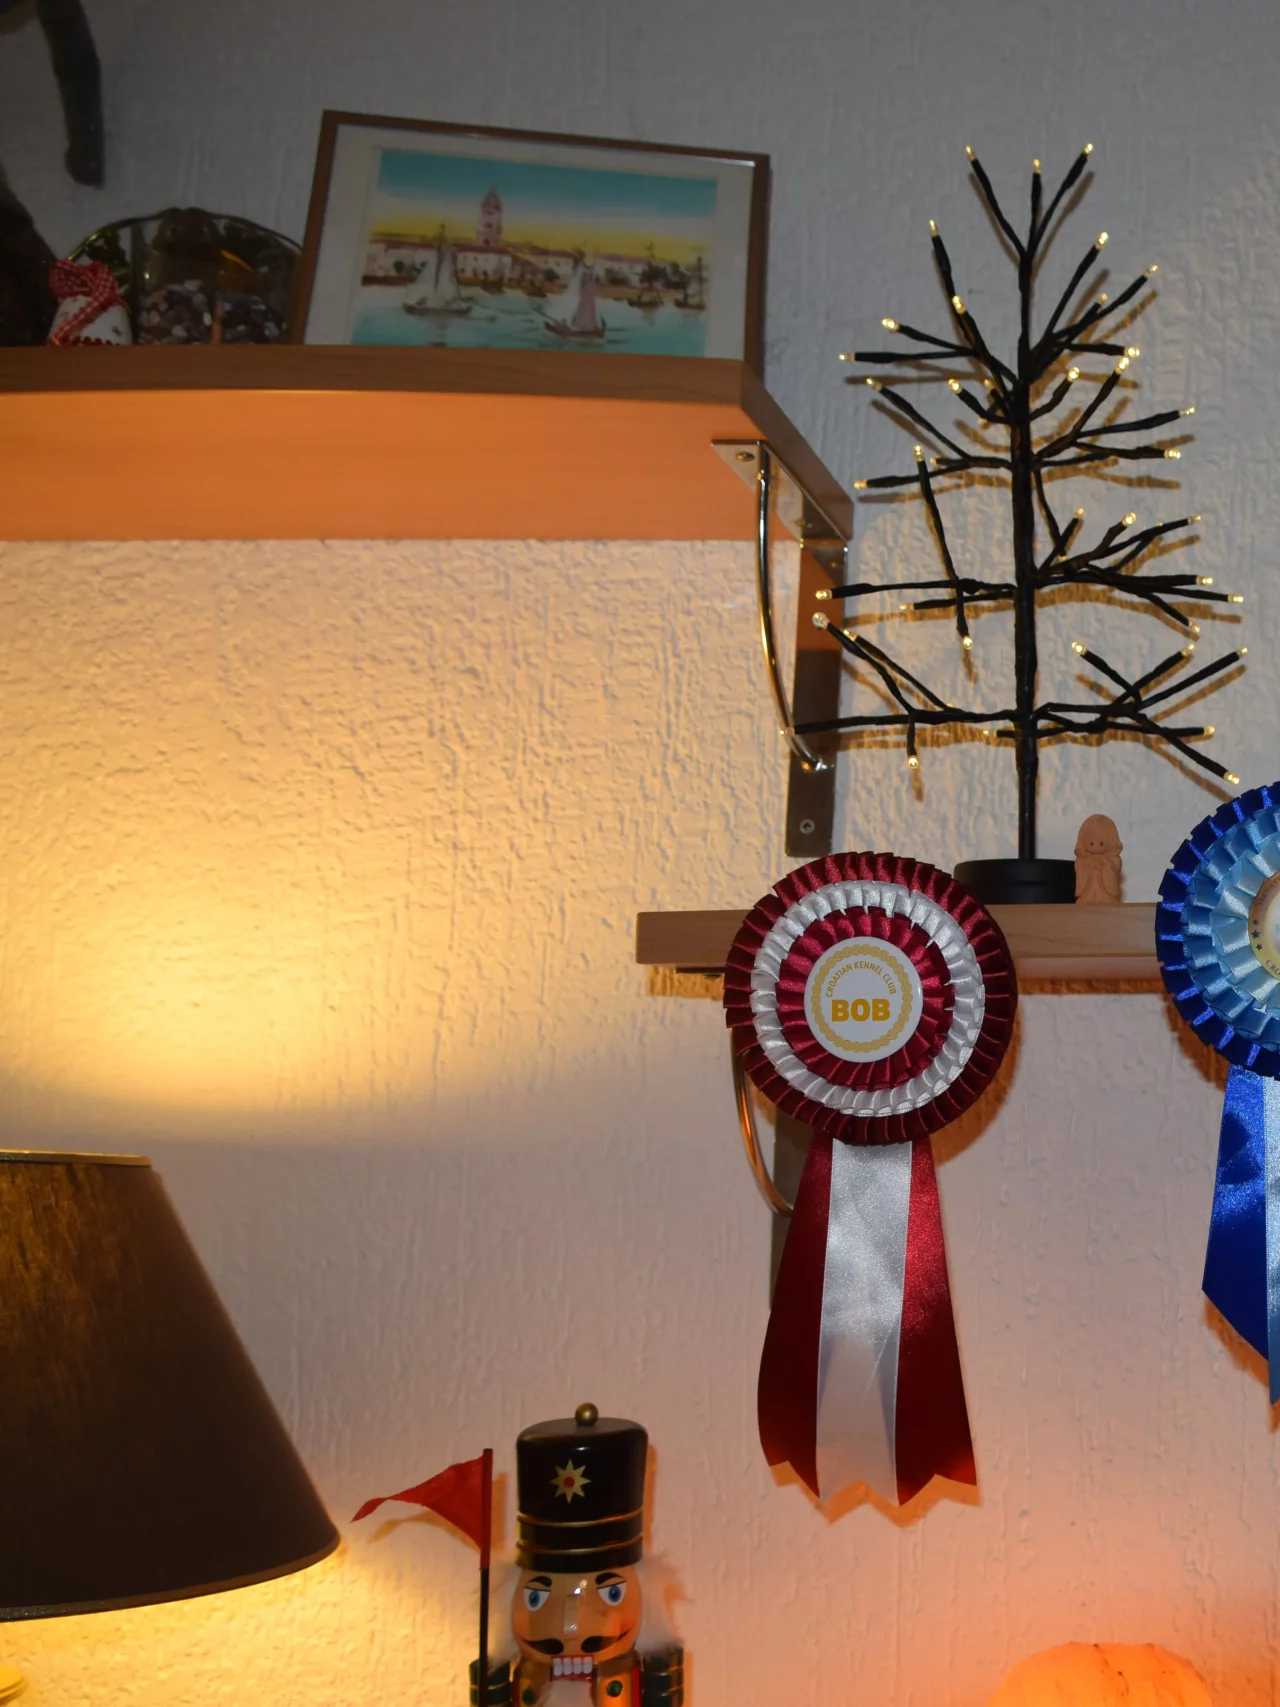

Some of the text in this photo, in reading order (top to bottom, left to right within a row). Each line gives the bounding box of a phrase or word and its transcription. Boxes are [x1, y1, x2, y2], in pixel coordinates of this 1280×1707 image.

[826, 961, 896, 997] CROATIAN KENNEL CLUB
[831, 999, 891, 1022] BOB
